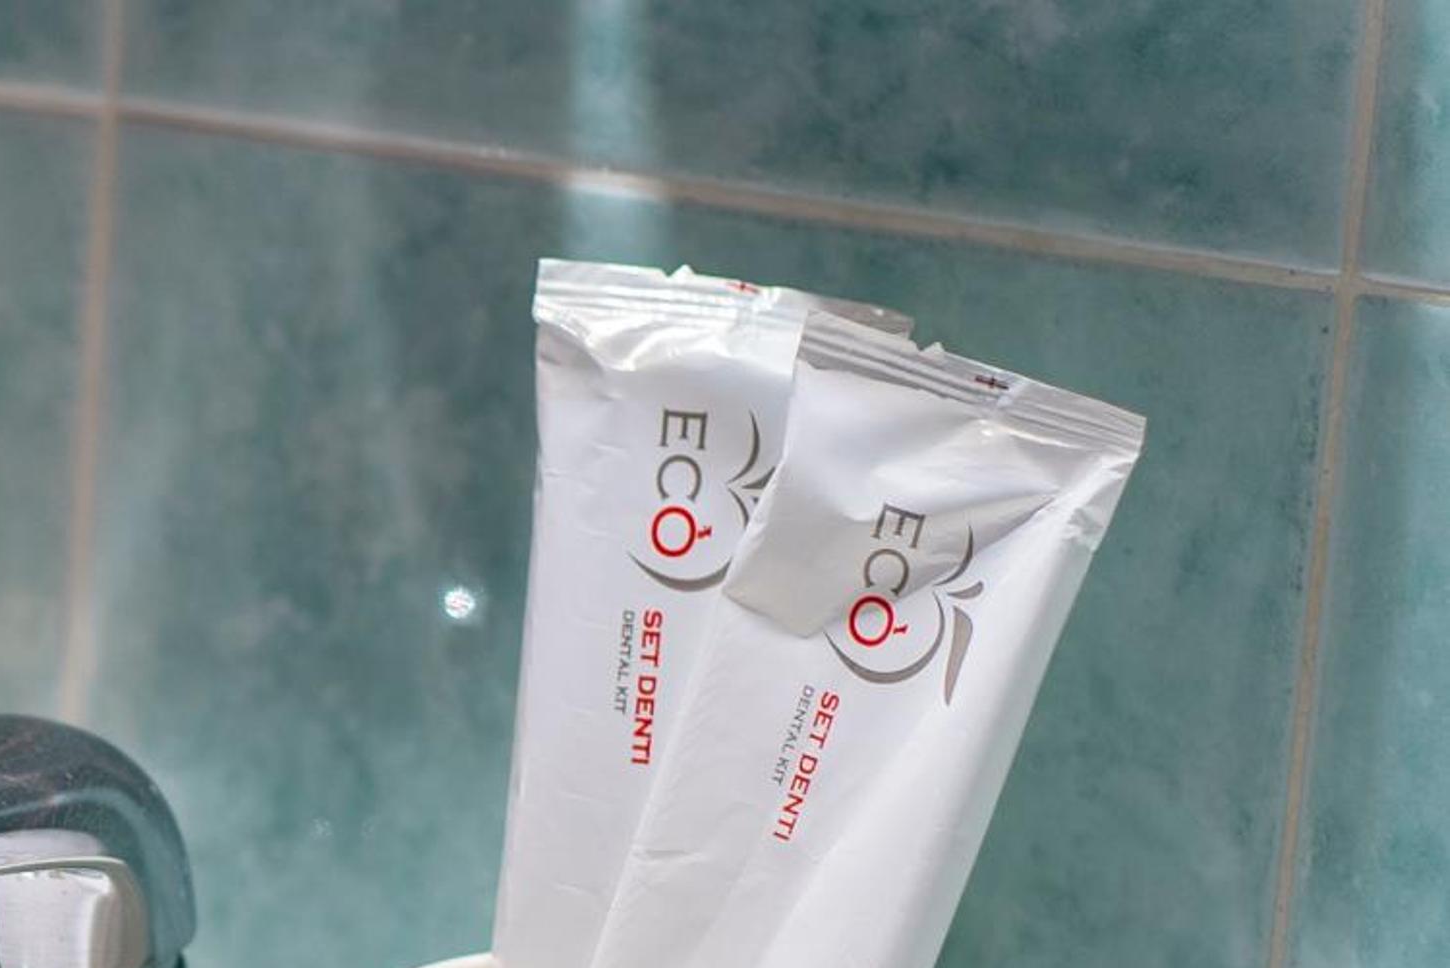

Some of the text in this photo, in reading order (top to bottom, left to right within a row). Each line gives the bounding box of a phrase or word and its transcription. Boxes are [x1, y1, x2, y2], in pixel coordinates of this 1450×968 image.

[614, 610, 635, 714] DENTAL KIT
[631, 610, 662, 765] SET DENTI
[772, 685, 815, 787] DENTAL KIT
[773, 691, 840, 841] SET DENTI
